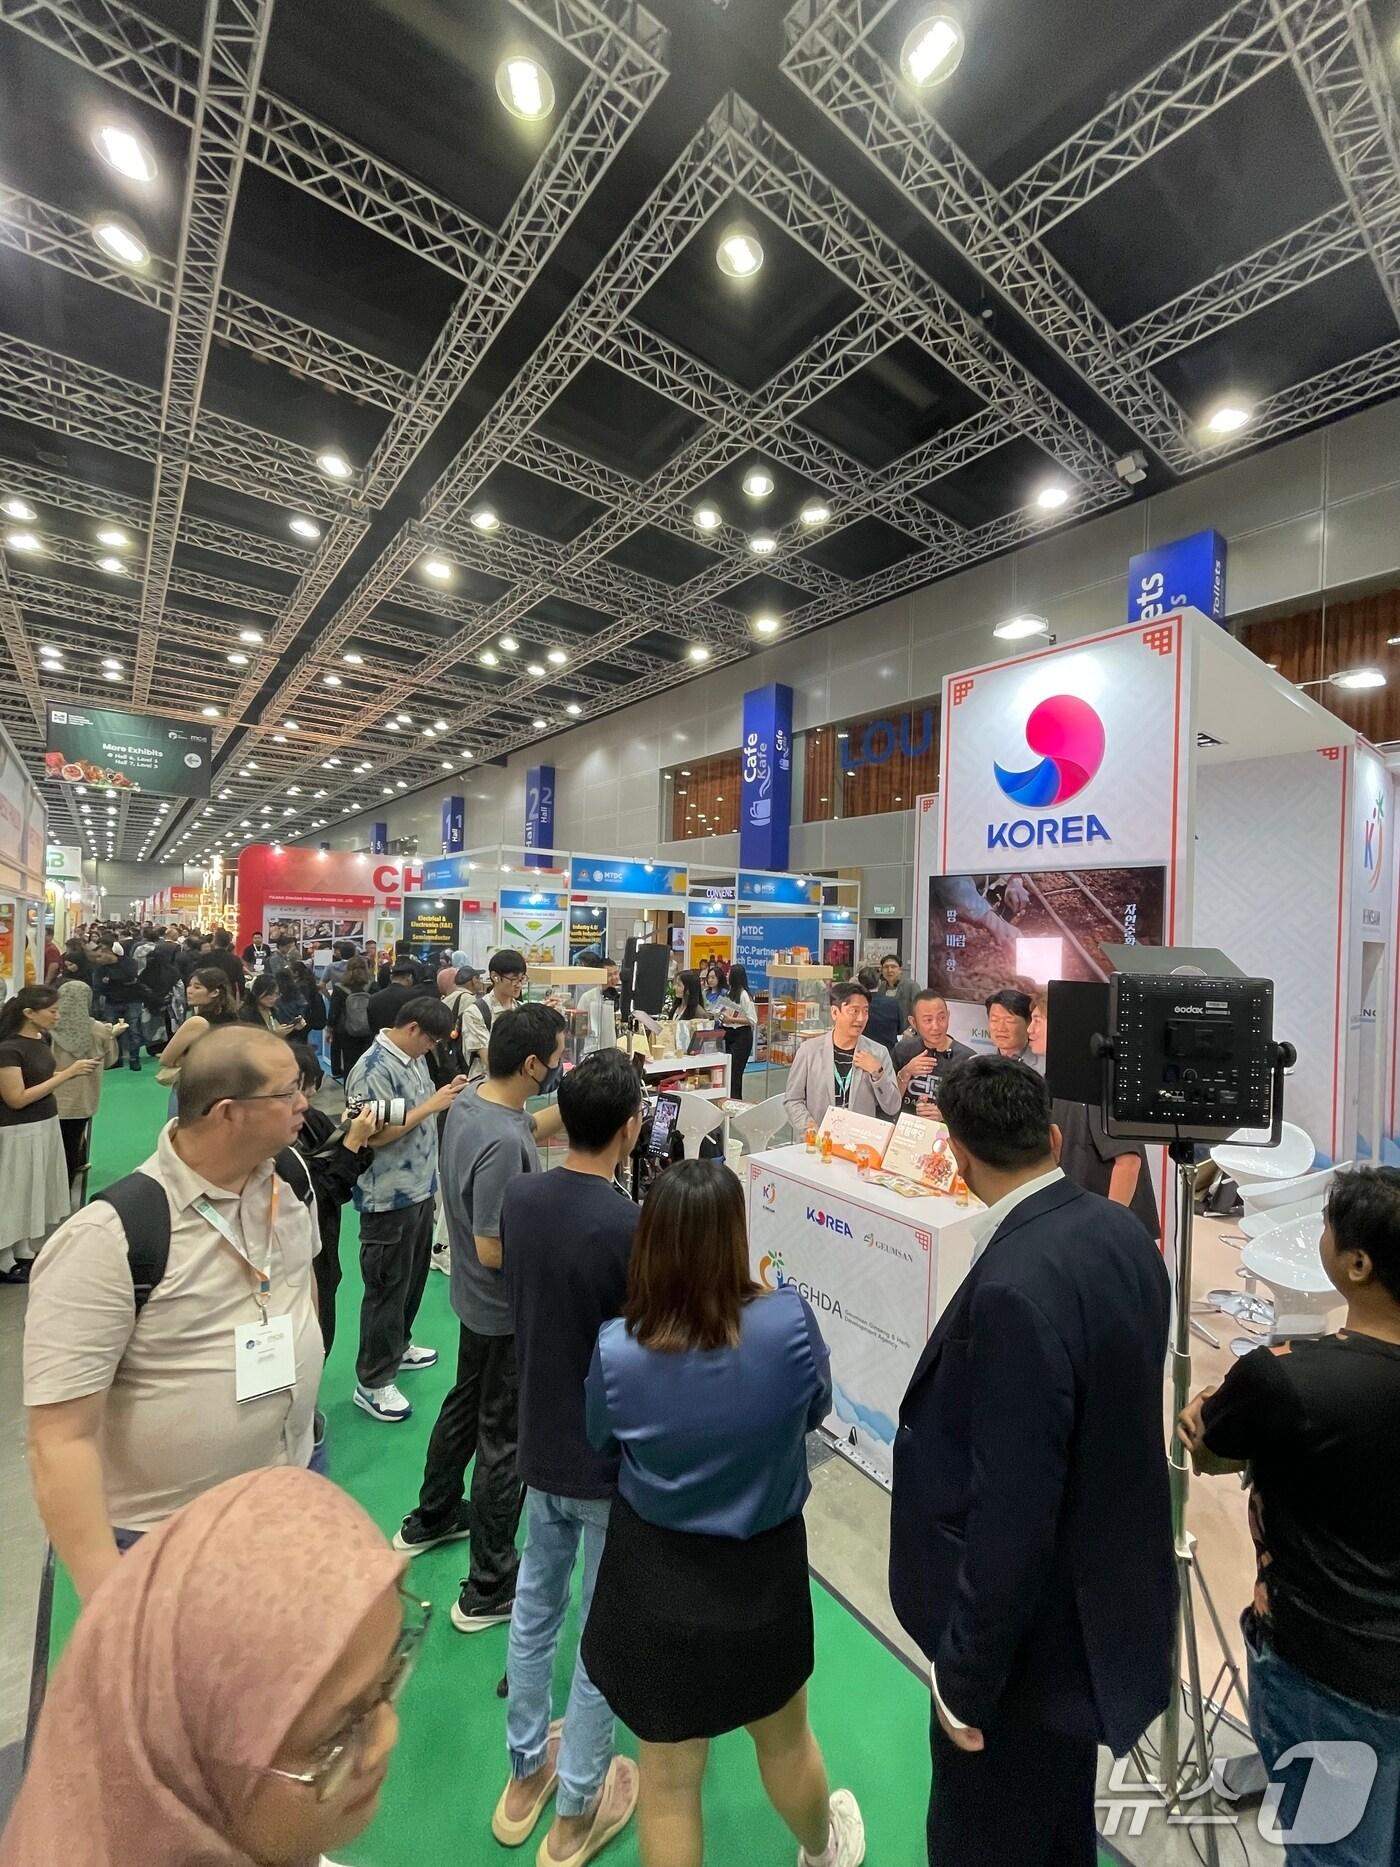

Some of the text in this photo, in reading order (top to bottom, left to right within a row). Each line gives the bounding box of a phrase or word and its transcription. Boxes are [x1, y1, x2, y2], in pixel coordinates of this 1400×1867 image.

[1212, 559, 1222, 615] Toilets
[102, 743, 164, 757] More Exhibits
[743, 732, 758, 783] Cafe
[757, 742, 768, 779] Kafe
[528, 787, 540, 821] 2
[540, 786, 553, 824] Hall 2
[456, 814, 462, 828] 1
[987, 814, 1111, 849] KOREA
[604, 871, 623, 880] MTDC
[741, 925, 764, 935] MTDC
[1174, 1005, 1203, 1014] Godox
[806, 1206, 854, 1239] KOREA
[875, 1241, 912, 1263] GEUMSAN
